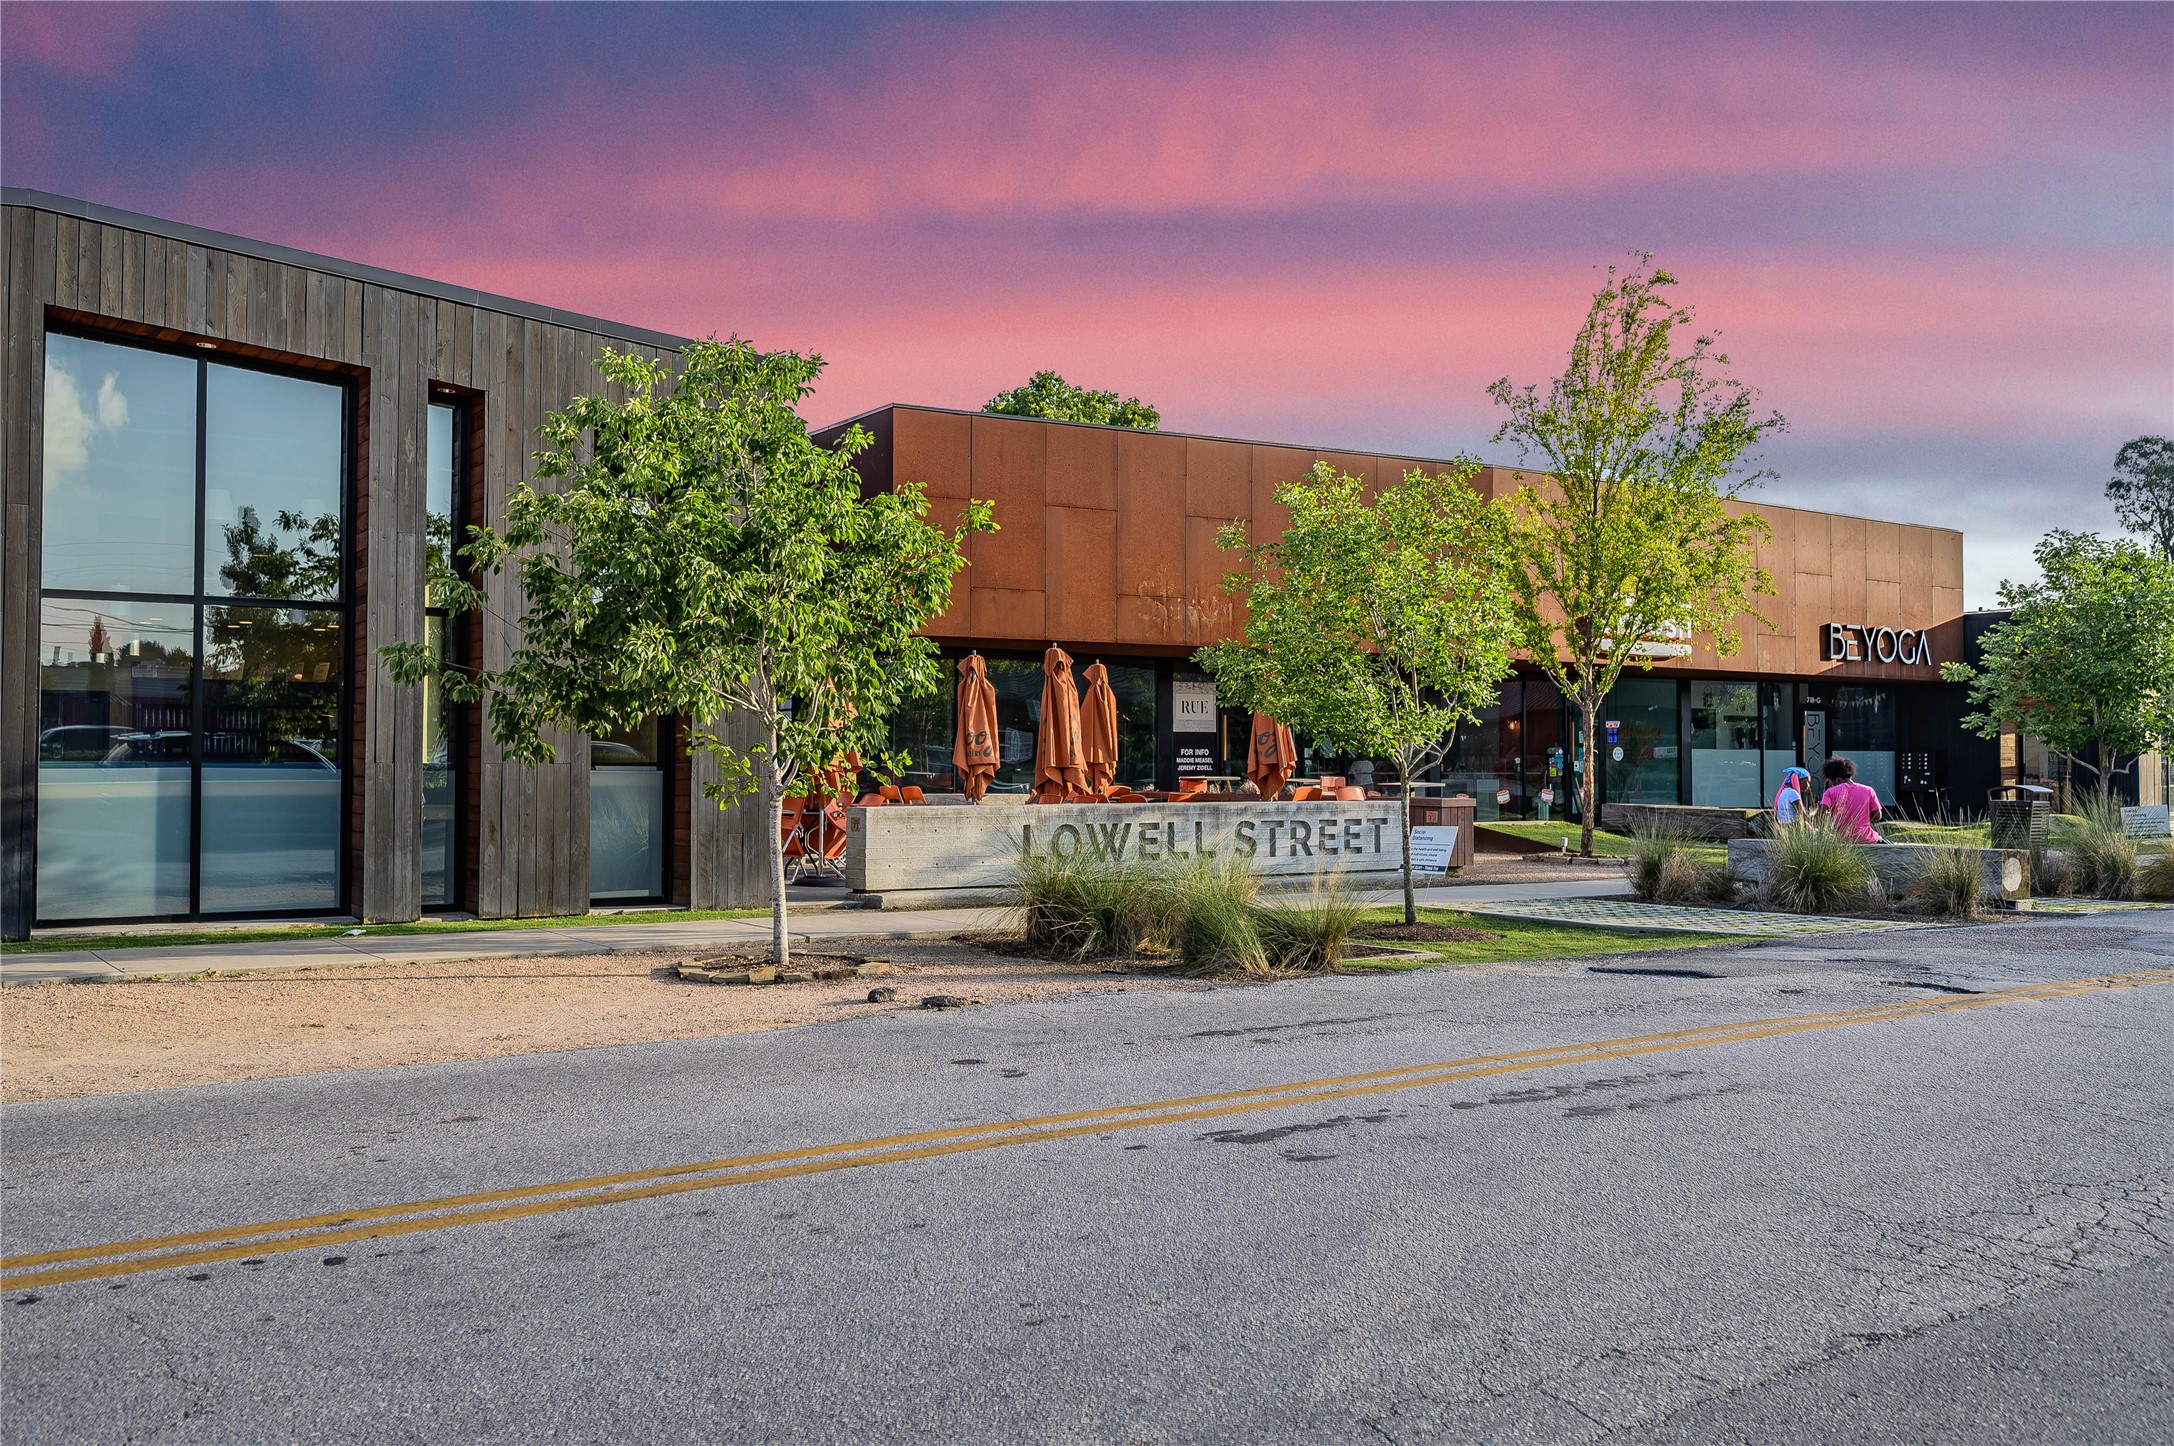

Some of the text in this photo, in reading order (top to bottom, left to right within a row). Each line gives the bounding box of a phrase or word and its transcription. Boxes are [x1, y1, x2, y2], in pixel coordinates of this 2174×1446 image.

[1829, 622, 1931, 666] BEYOGA
[1181, 700, 1209, 714] RUE
[1180, 748, 1210, 756] FOR INFO
[1022, 816, 1389, 863] LOWELL STREET
